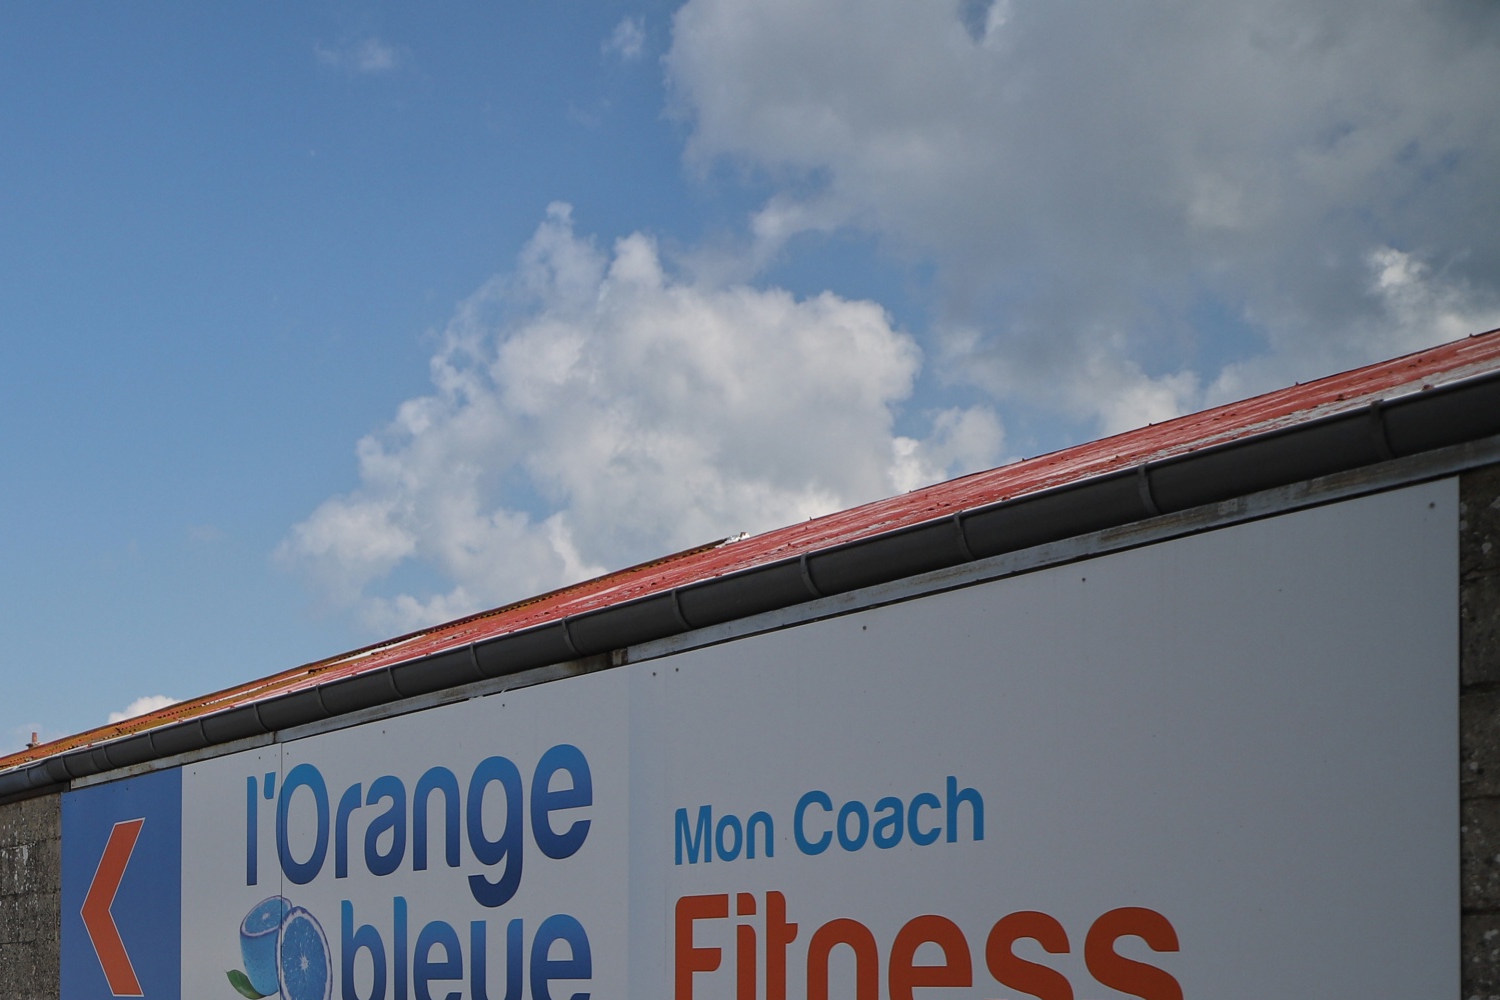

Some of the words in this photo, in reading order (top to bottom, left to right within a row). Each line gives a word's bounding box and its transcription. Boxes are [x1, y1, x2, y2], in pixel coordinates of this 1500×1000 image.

[245, 743, 593, 908] l'Orange
[674, 804, 775, 866] Mon
[793, 775, 986, 856] Coach
